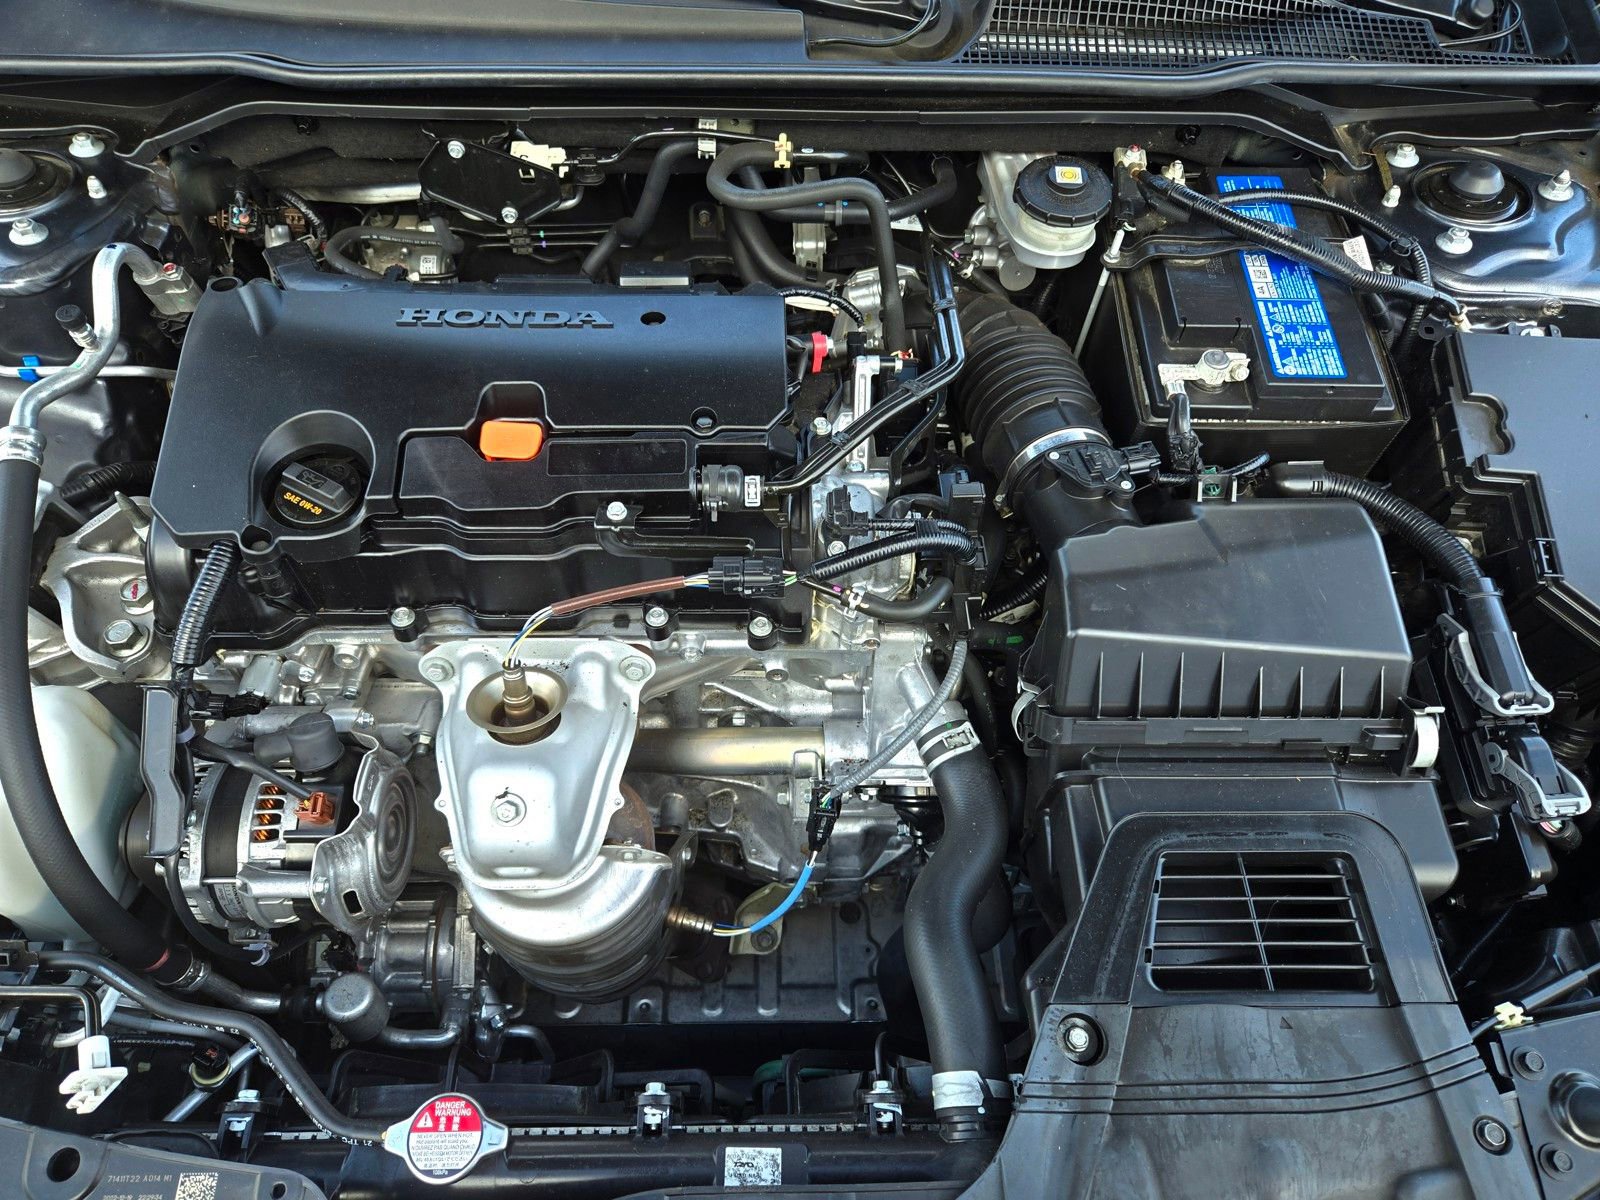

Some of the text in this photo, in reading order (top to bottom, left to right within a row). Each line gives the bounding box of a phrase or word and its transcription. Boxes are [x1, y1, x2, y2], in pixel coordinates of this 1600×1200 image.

[396, 308, 614, 328] HONDA
[283, 492, 322, 515] SAE 0W-20
[435, 1101, 466, 1109] DANGER
[435, 1108, 472, 1116] WARNUNG
